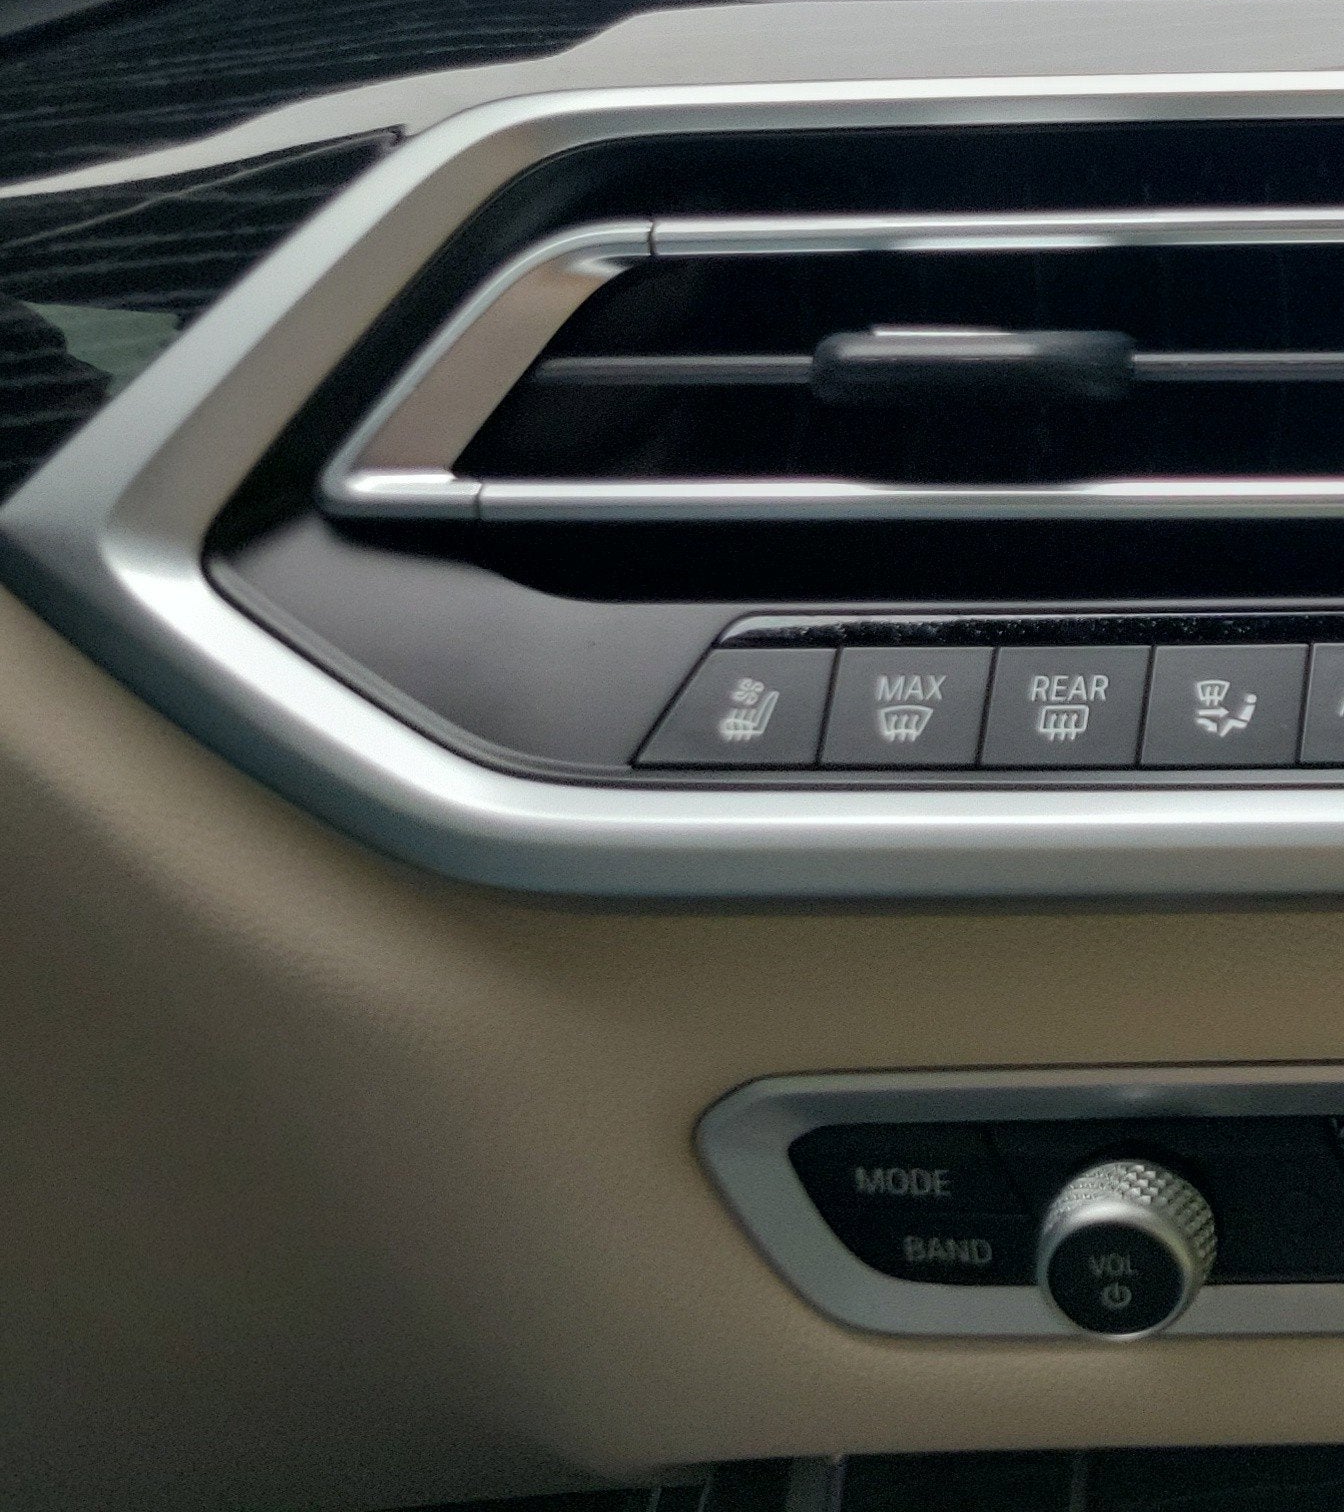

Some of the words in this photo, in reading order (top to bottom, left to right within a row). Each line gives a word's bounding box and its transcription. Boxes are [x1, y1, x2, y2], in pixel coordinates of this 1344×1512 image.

[876, 676, 945, 701] MAX
[1029, 675, 1108, 701] REAR
[855, 1167, 950, 1196] MODE
[904, 1236, 992, 1264] BAND
[1089, 1253, 1137, 1277] VOL
